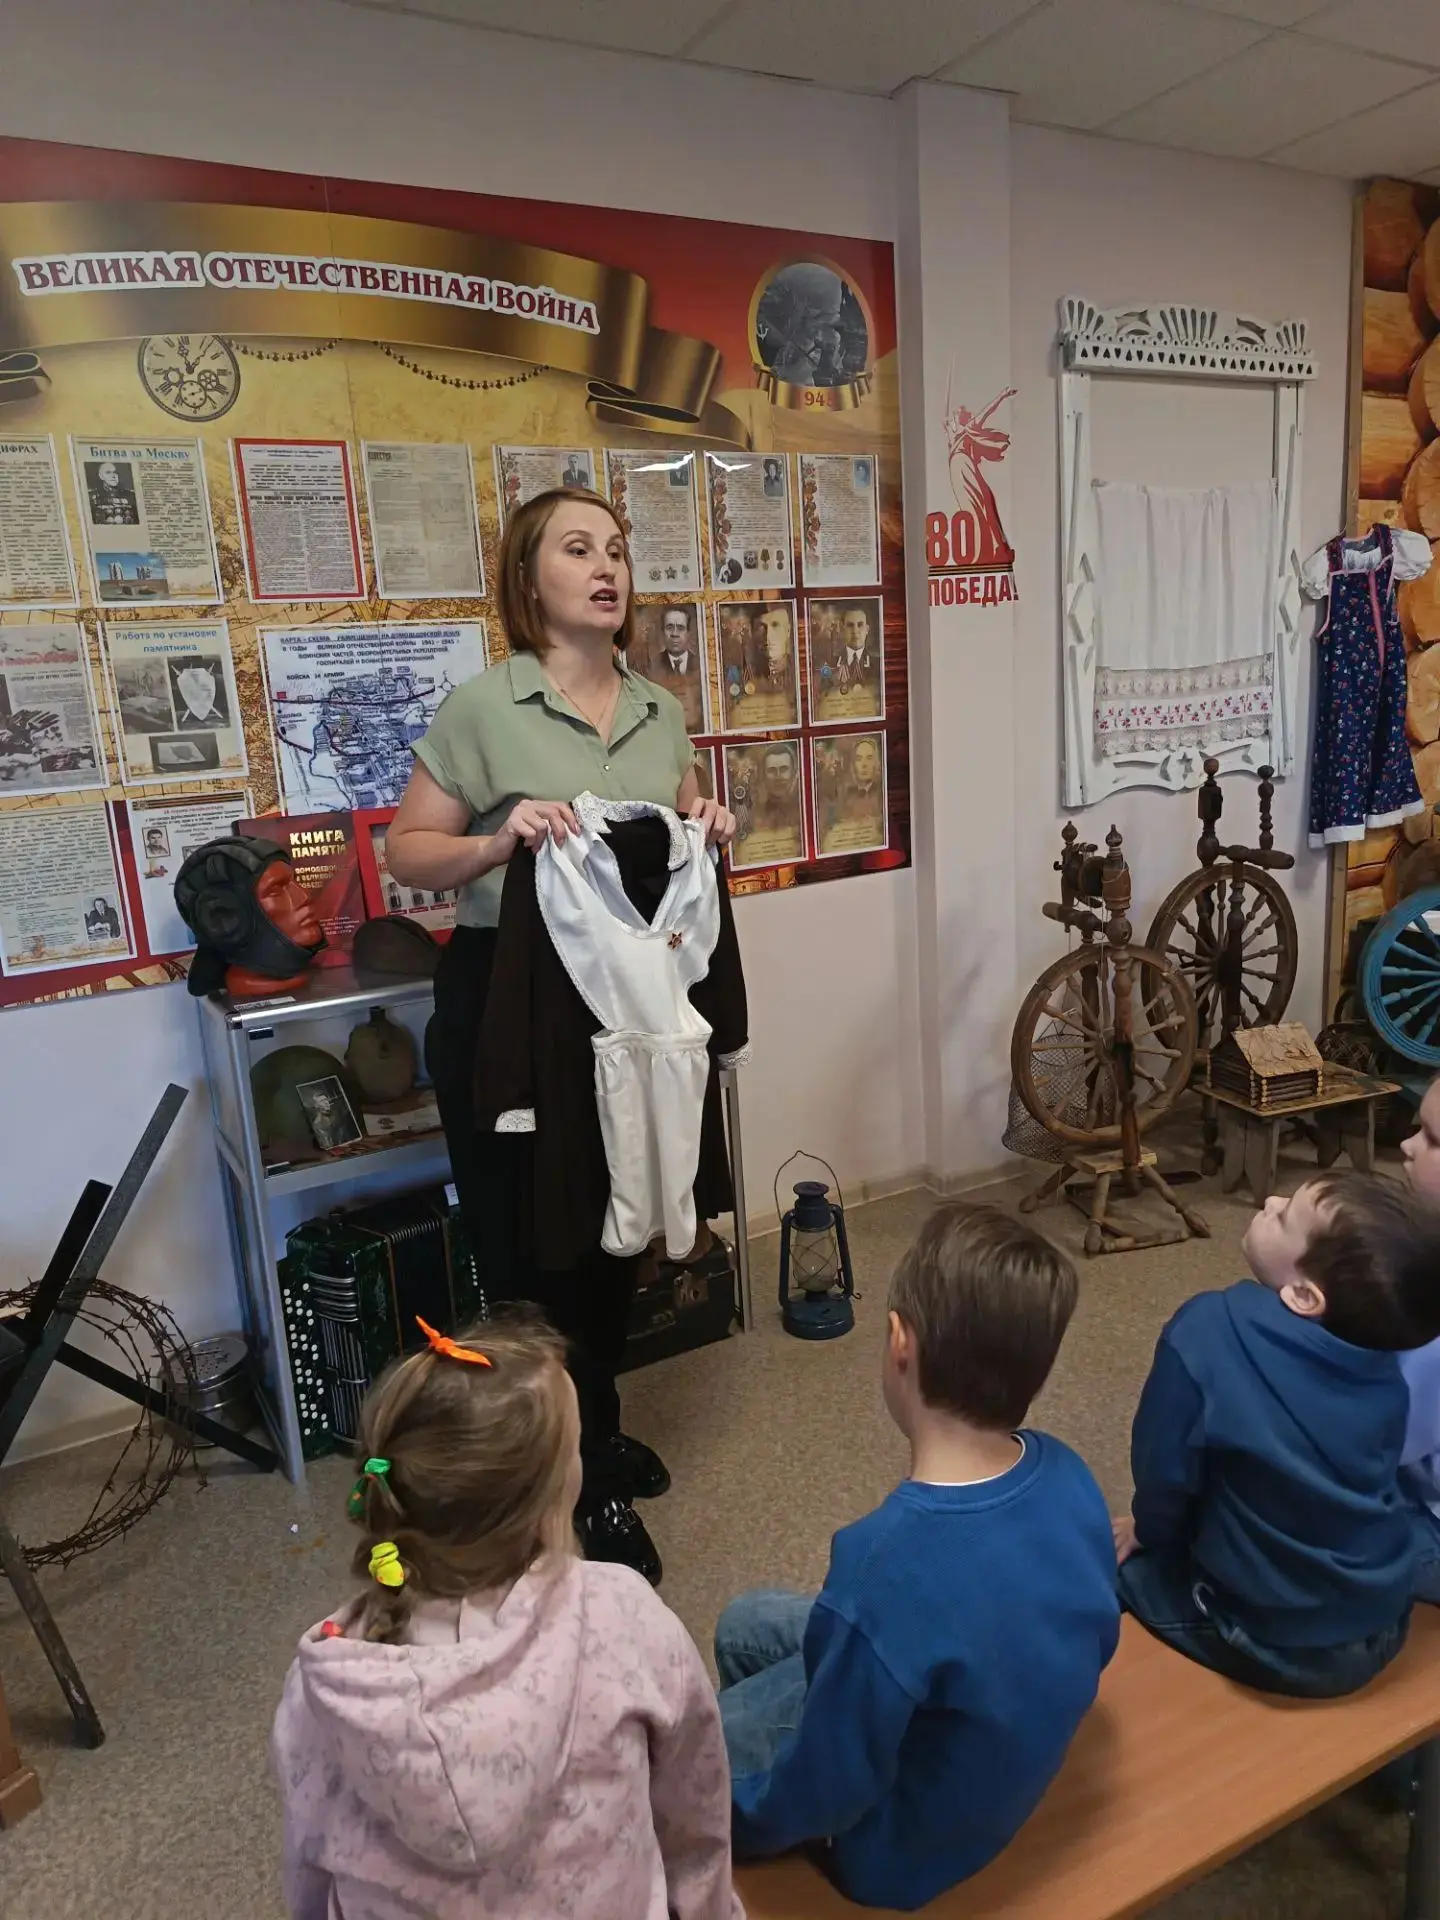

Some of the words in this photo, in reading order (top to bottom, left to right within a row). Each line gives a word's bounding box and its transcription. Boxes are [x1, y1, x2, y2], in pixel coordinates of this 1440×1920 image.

[19, 257, 199, 288] ВЕЛИКАЯ
[208, 258, 486, 305] ОТЕЧЕСТВЕННАЯ
[497, 286, 596, 330] ВОЙНА
[0, 444, 38, 455] ИФРАХ
[90, 446, 127, 457] Битва
[145, 447, 190, 460] Москву
[926, 511, 975, 566] 80
[928, 574, 1019, 608] ПОБЕДА!
[115, 631, 150, 641] Работа
[153, 632, 165, 640] по
[168, 629, 217, 640] установке
[143, 644, 198, 653] памятника
[289, 829, 345, 846] КНИГА
[291, 844, 346, 858] ПАМЯТИ
